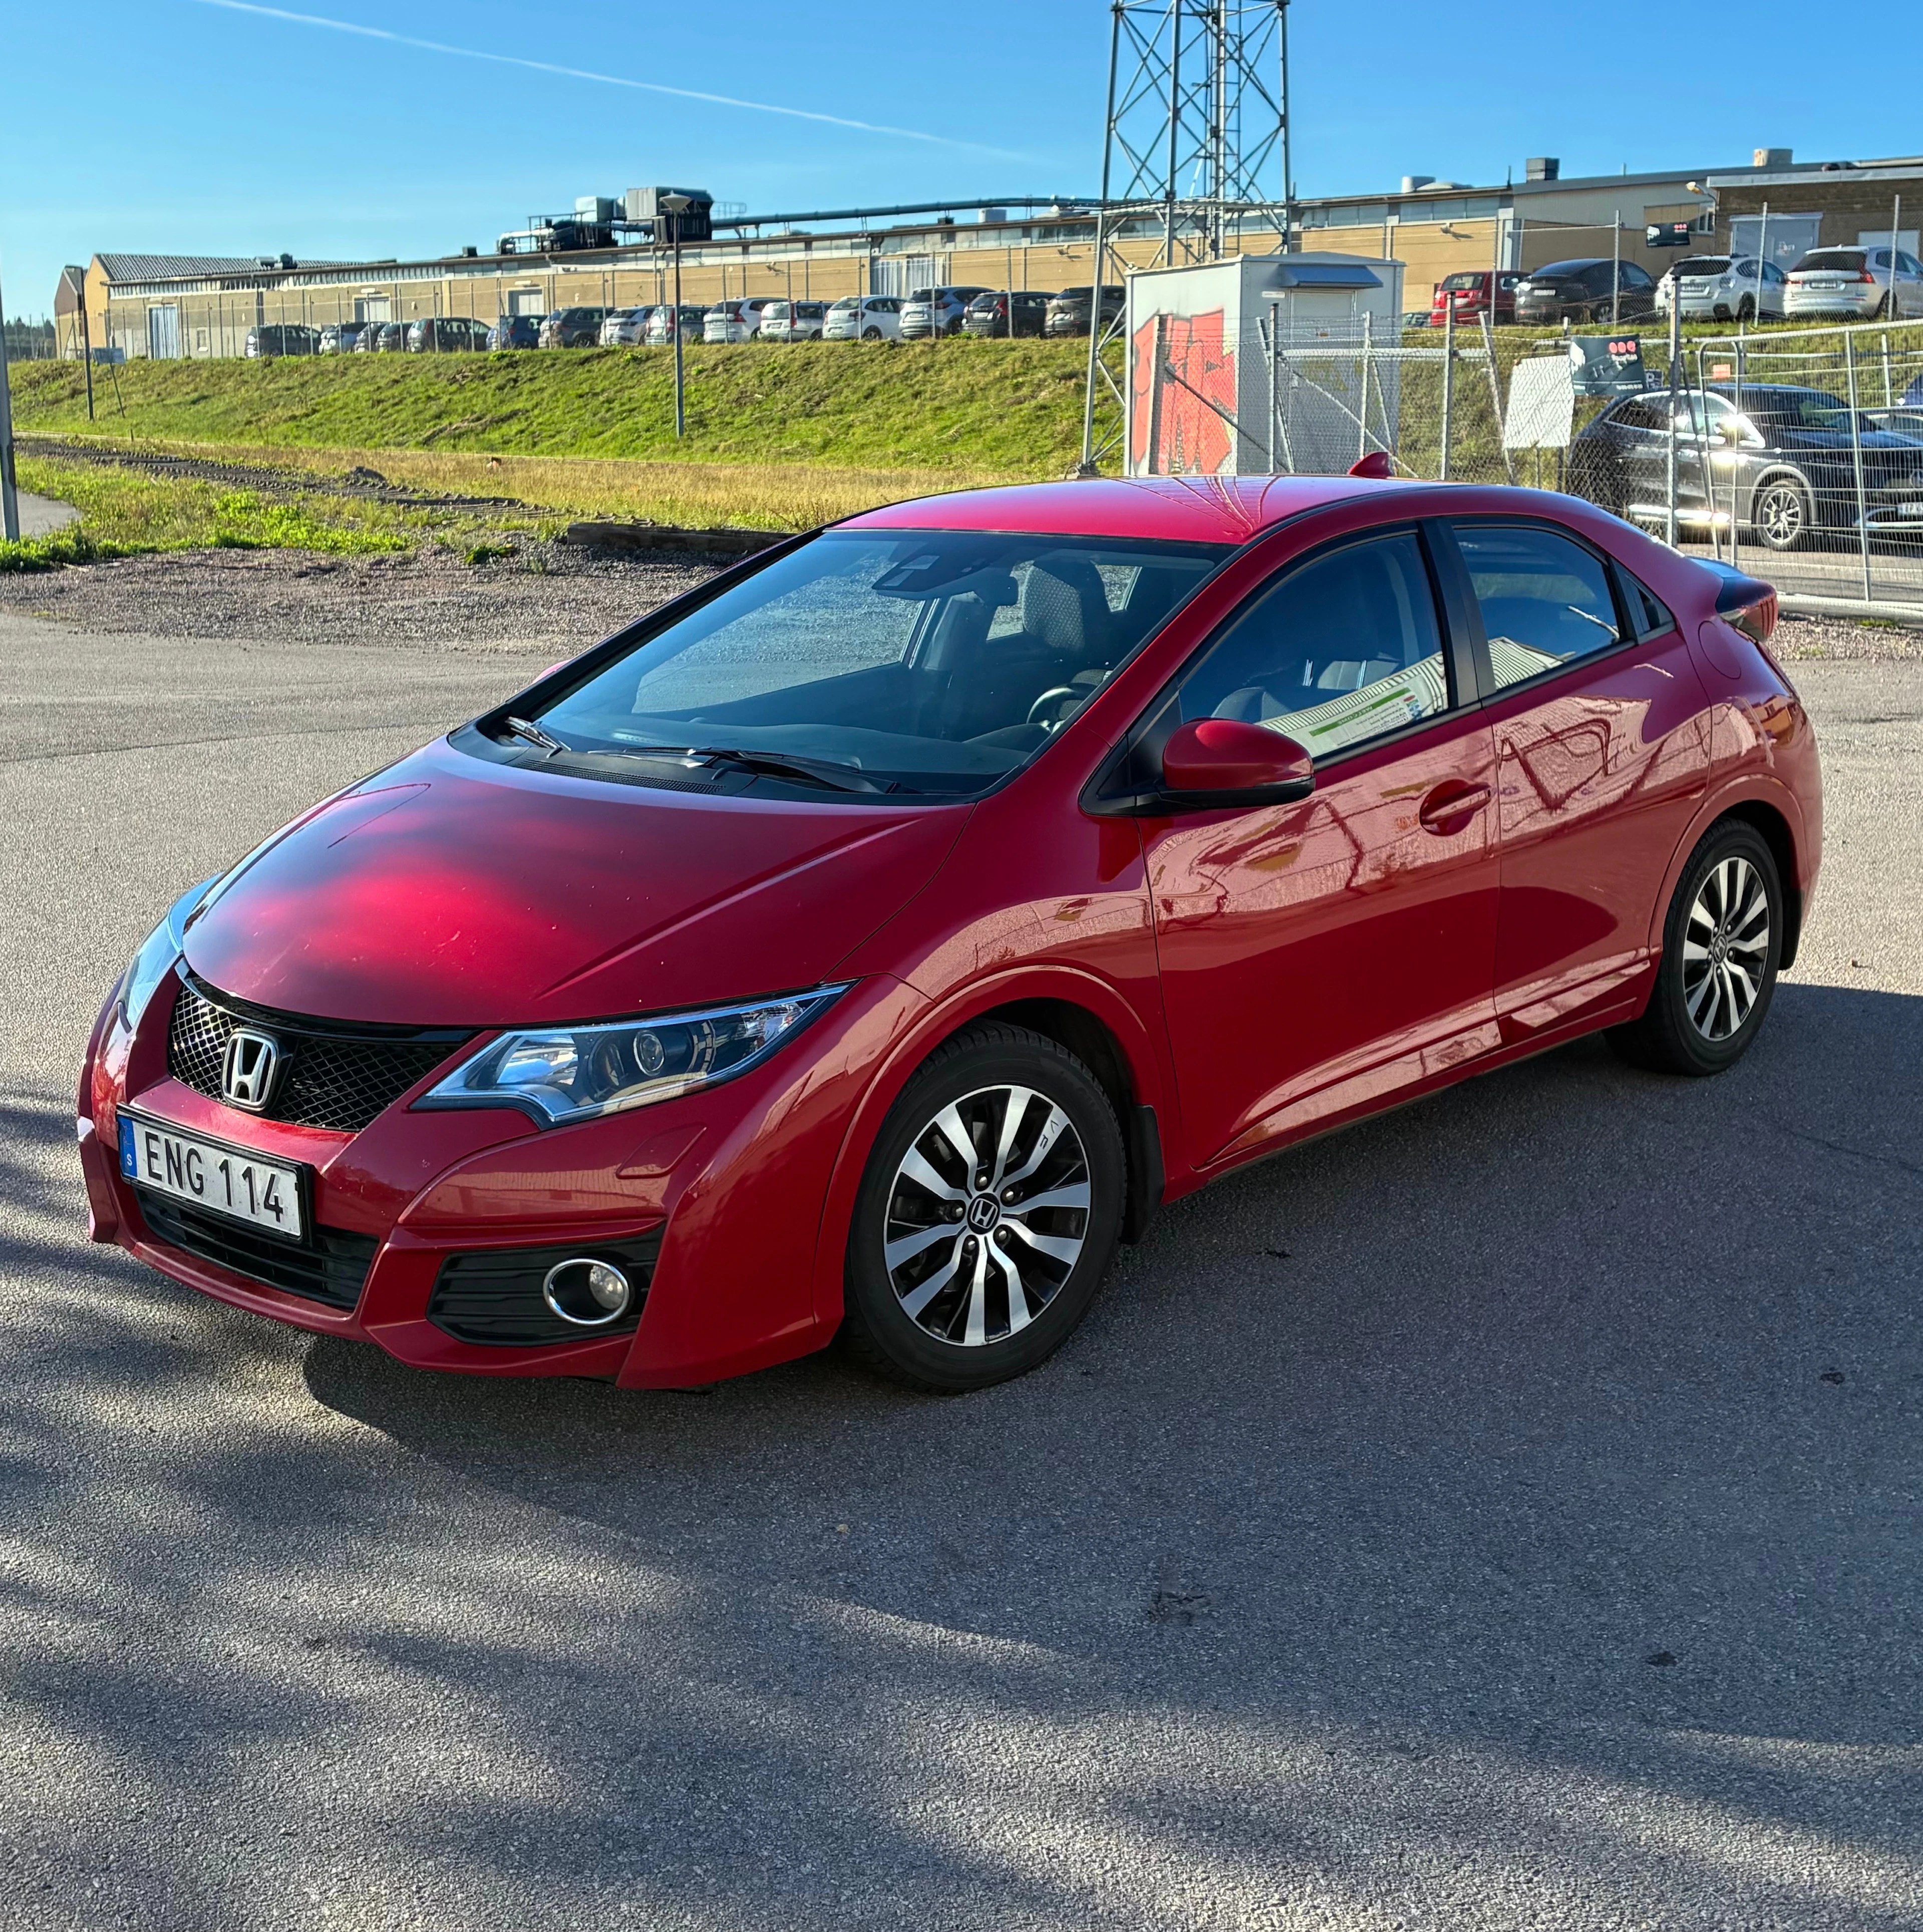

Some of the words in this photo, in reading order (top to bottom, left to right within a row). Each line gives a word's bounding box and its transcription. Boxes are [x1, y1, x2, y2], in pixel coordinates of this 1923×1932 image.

[126, 1153, 133, 1166] S
[145, 1131, 204, 1195] ENG
[219, 1159, 284, 1223] 114
